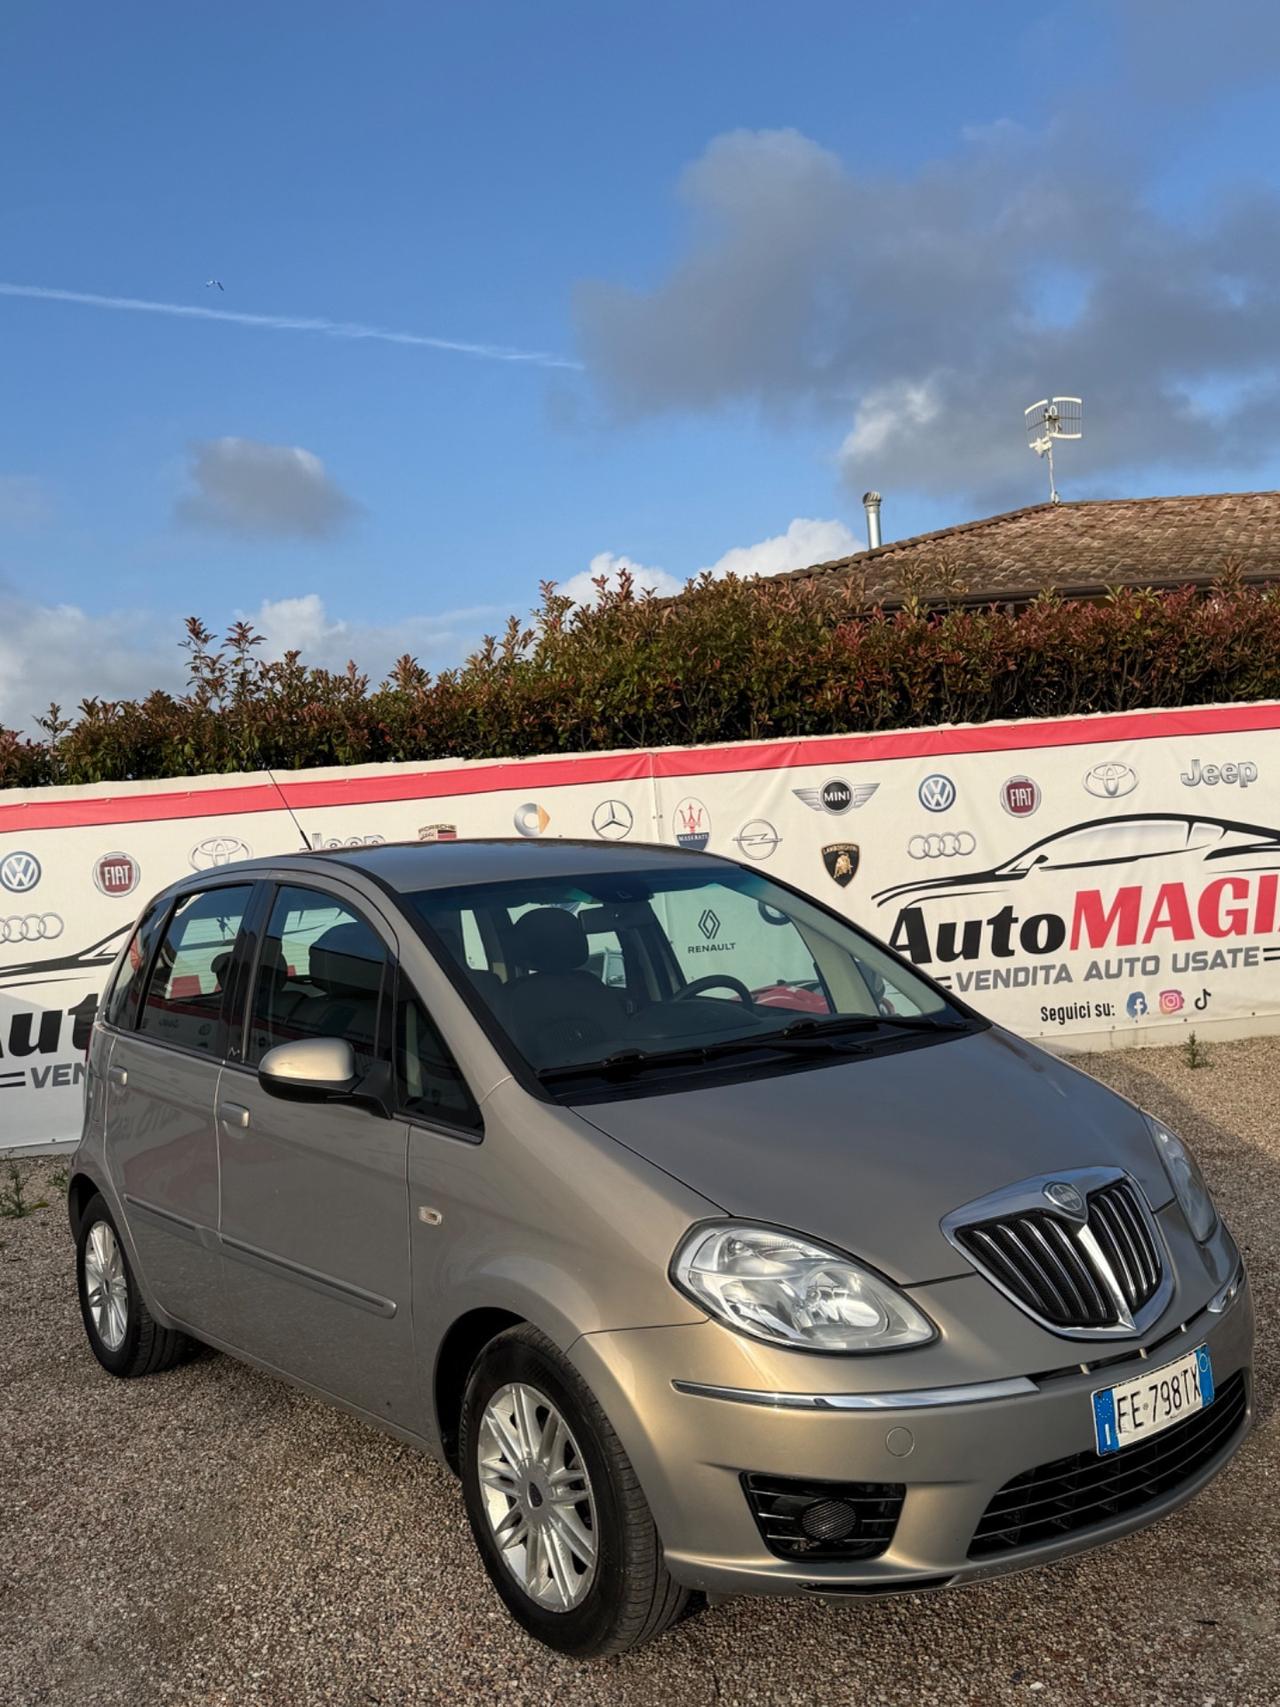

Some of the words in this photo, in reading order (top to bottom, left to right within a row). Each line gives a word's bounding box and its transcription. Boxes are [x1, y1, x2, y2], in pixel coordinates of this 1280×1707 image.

[1180, 759, 1258, 788] Jeep
[824, 791, 850, 802] MINI
[1010, 787, 1033, 808] FIAT
[104, 865, 130, 886] FIAT
[888, 873, 1280, 965] AutoMAGI
[687, 942, 737, 954] RENAULT
[955, 963, 1073, 992] VENDITA
[1083, 955, 1160, 982] AUTO
[1172, 947, 1260, 973] USATE
[1040, 1001, 1092, 1026] Seguici
[1095, 1003, 1116, 1017] su:
